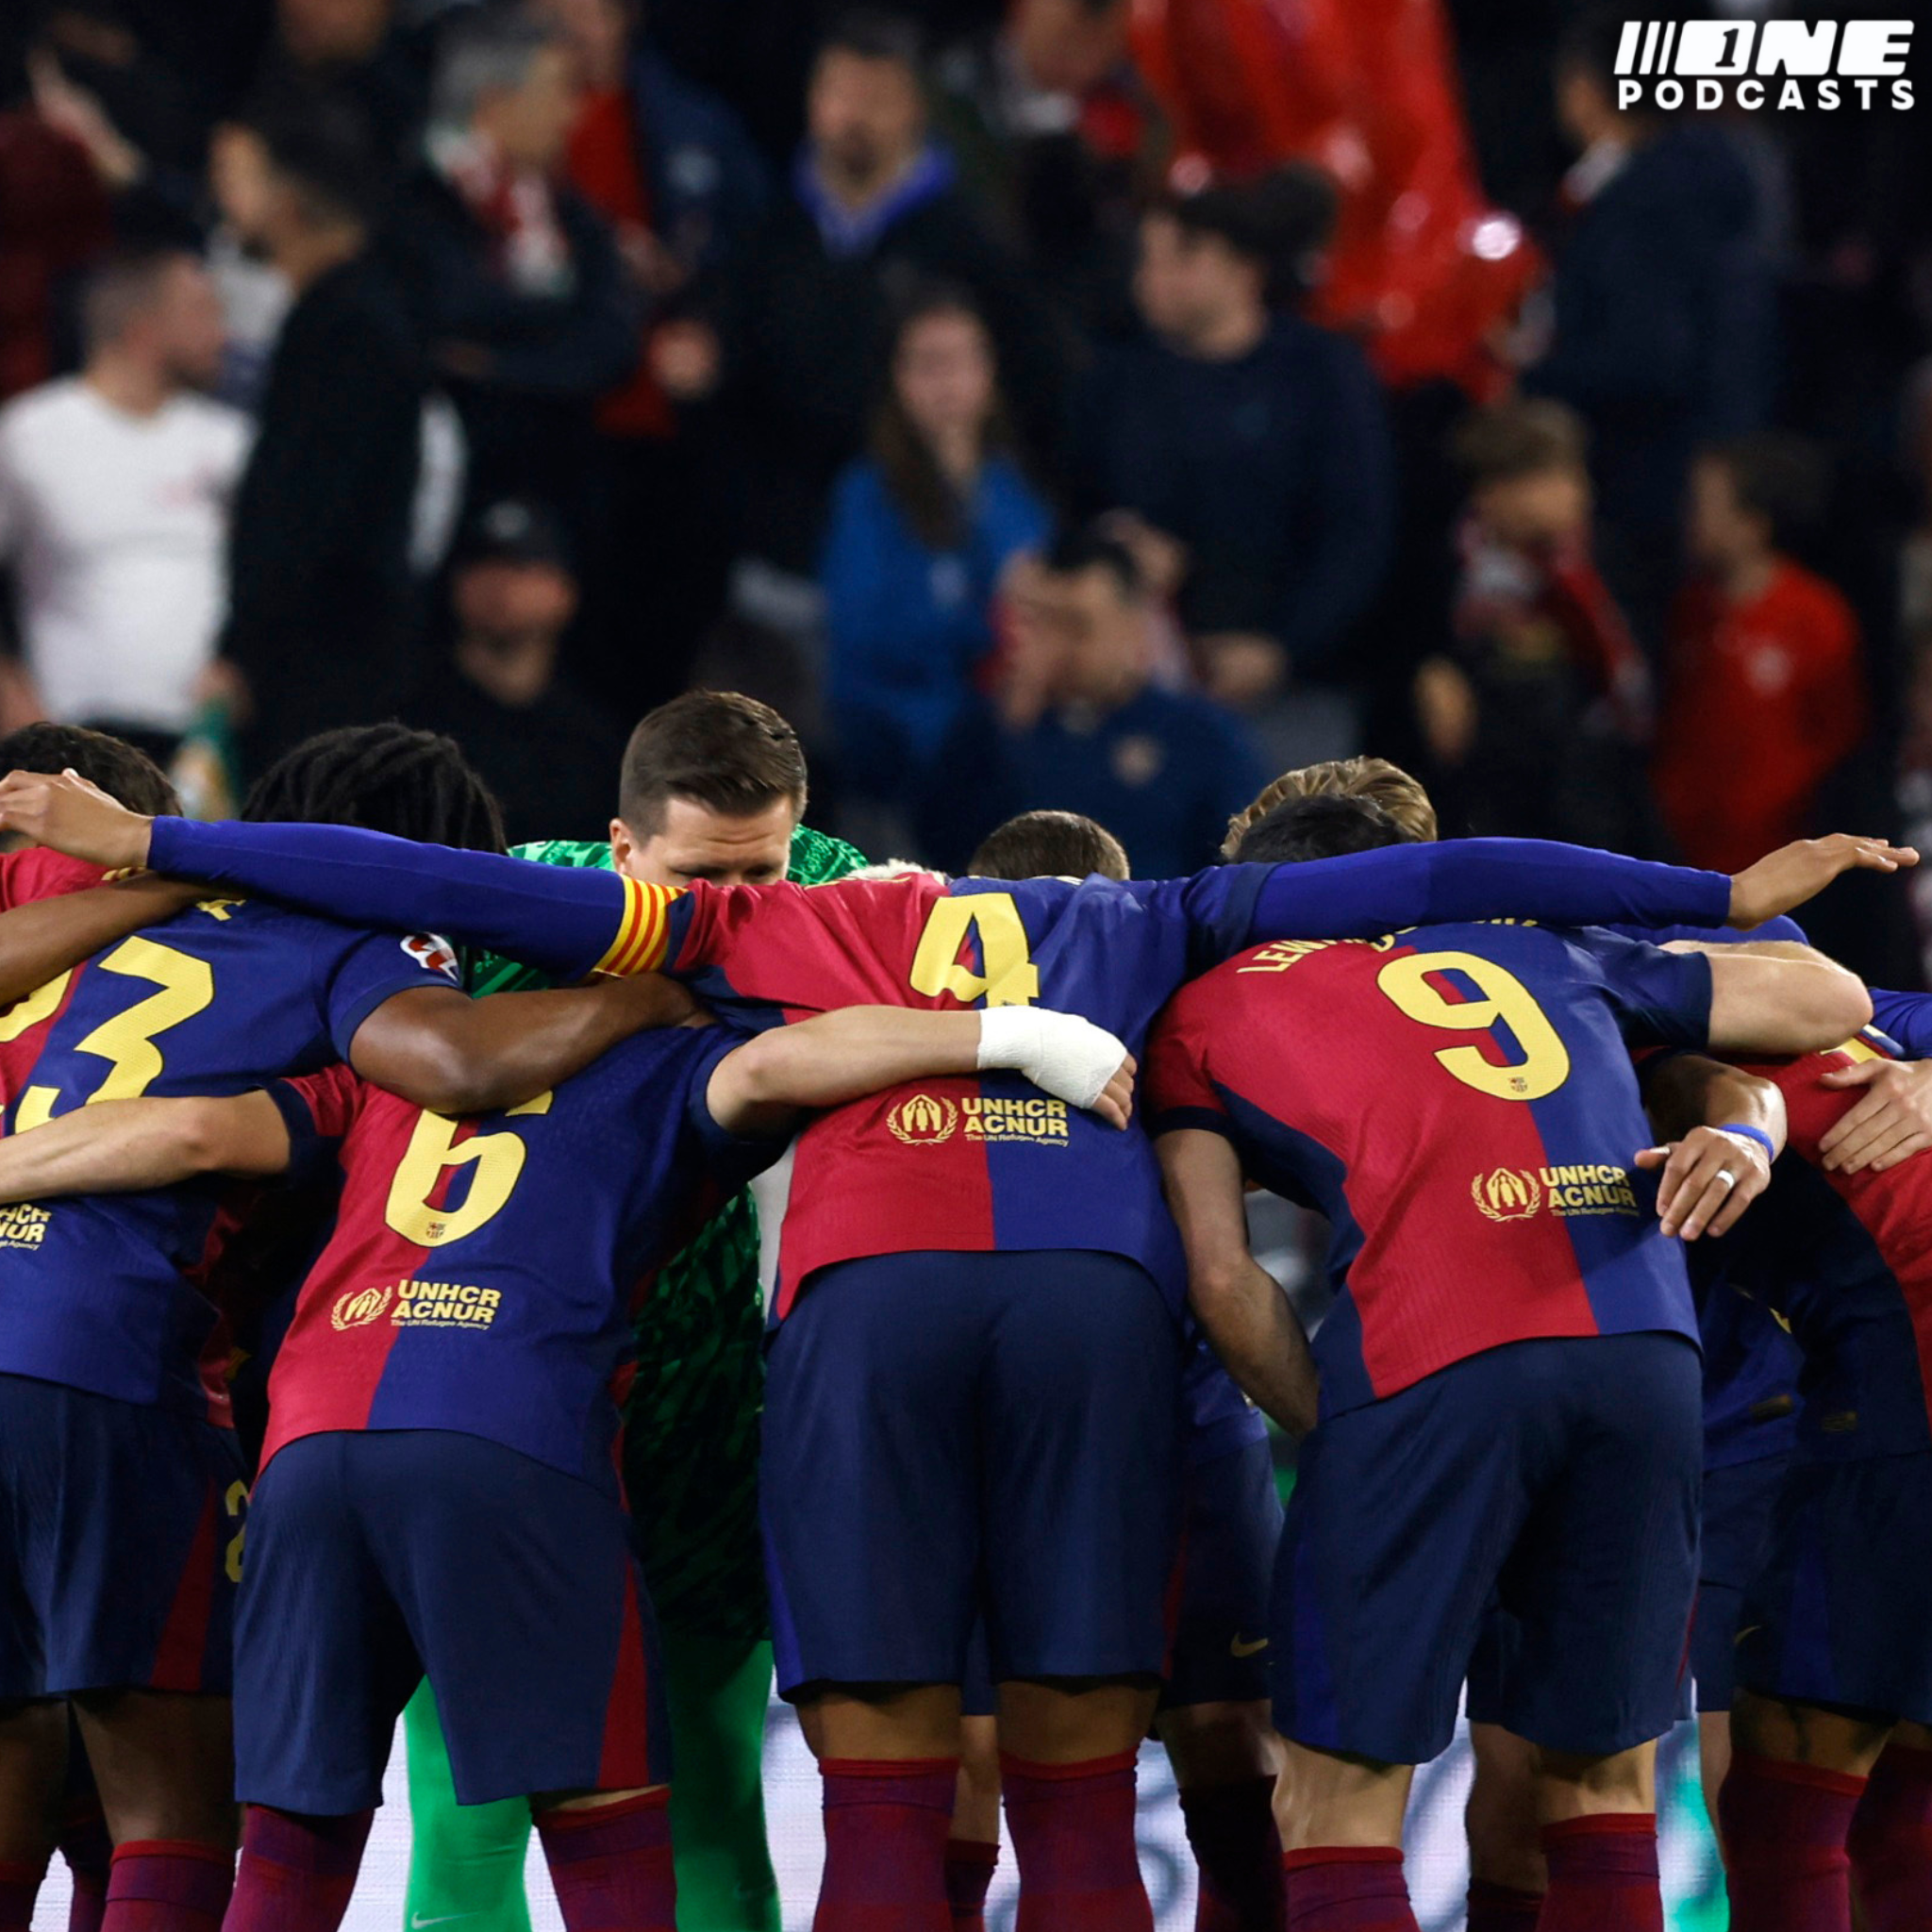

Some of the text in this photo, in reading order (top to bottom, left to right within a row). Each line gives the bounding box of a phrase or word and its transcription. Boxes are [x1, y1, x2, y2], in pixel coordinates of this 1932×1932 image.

[909, 892, 1040, 1007] 4
[1376, 951, 1571, 1102] 9
[961, 1097, 1067, 1118] UNHCR
[963, 1115, 1069, 1137] ACNUR
[384, 1090, 554, 1248] 6
[1539, 1165, 1629, 1187] UNHCR
[1548, 1185, 1637, 1208] ACNUR
[398, 1279, 502, 1307] UNHCR
[391, 1300, 495, 1324] ACNUR
